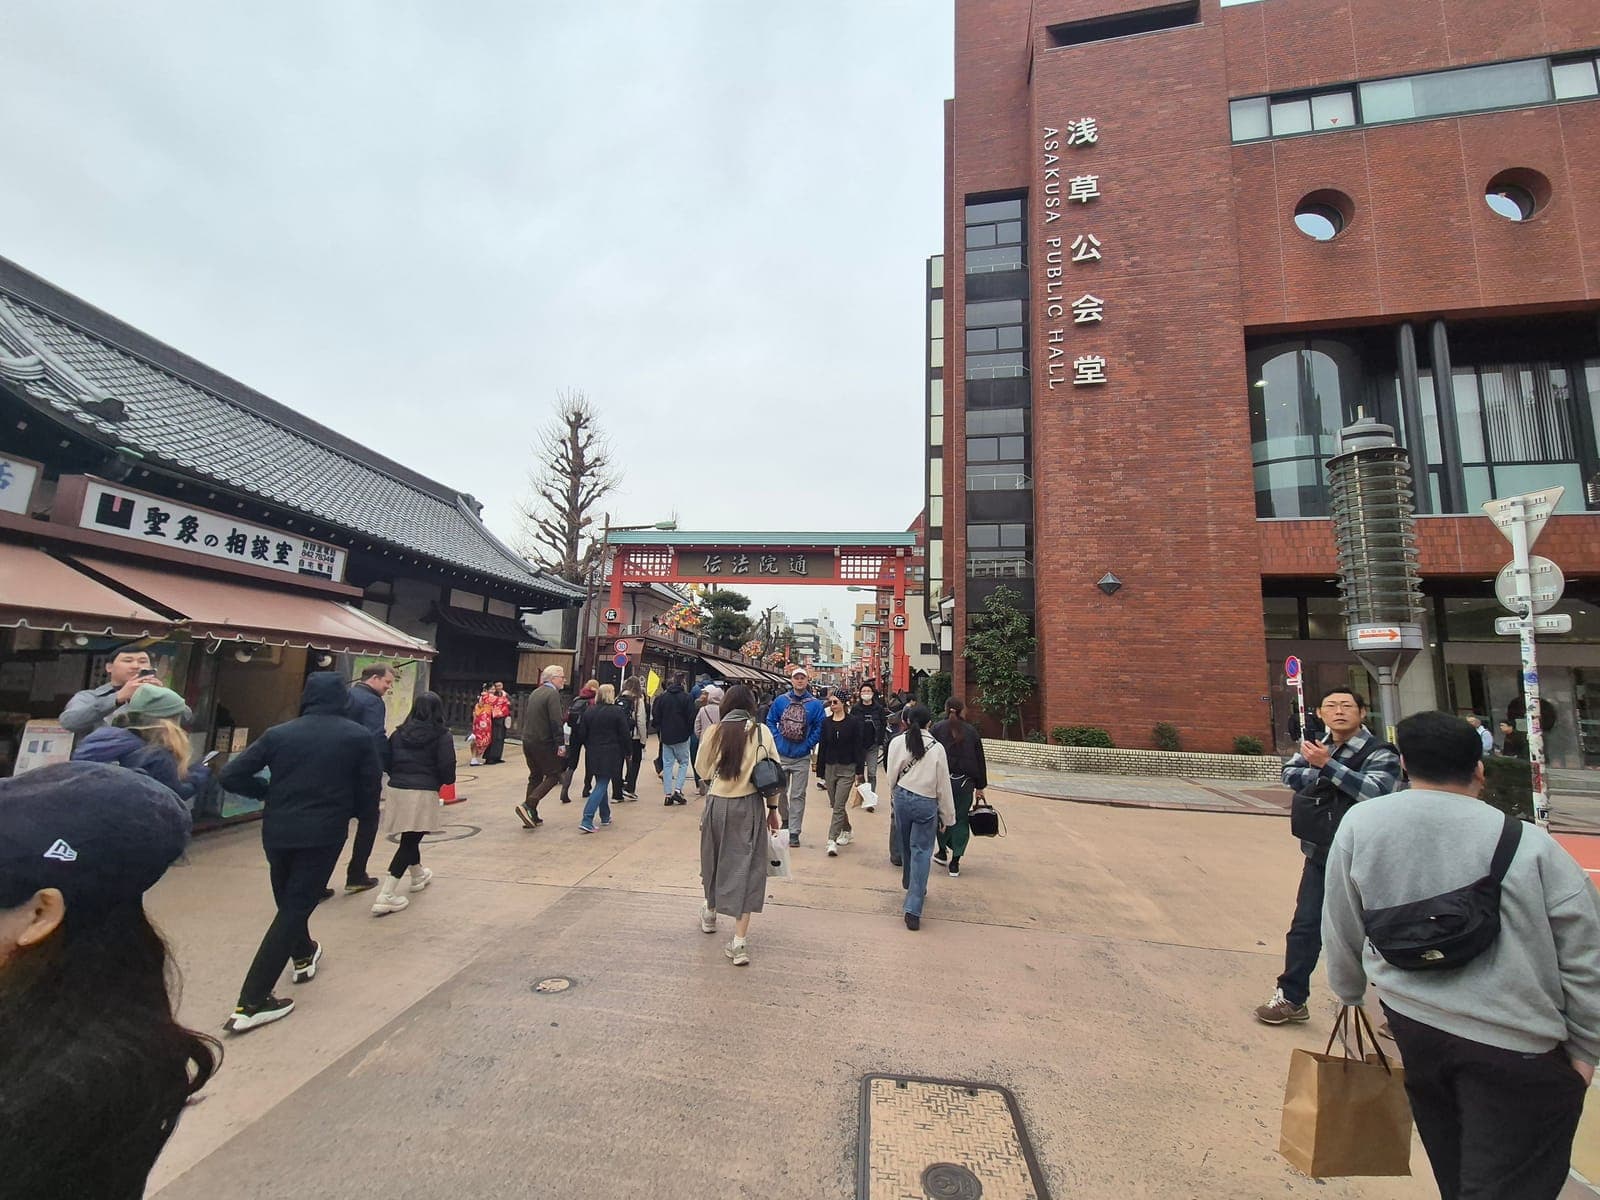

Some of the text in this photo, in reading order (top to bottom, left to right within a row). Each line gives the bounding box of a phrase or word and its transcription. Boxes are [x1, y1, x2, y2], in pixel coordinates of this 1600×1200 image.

[1044, 127, 1065, 390] ASAKUSA PUBLIC HALL
[1067, 117, 1107, 384] 浅草公会堂
[143, 506, 294, 566] 聖象の相談室
[703, 554, 808, 575] 伝法院通
[617, 642, 626, 651] 30
